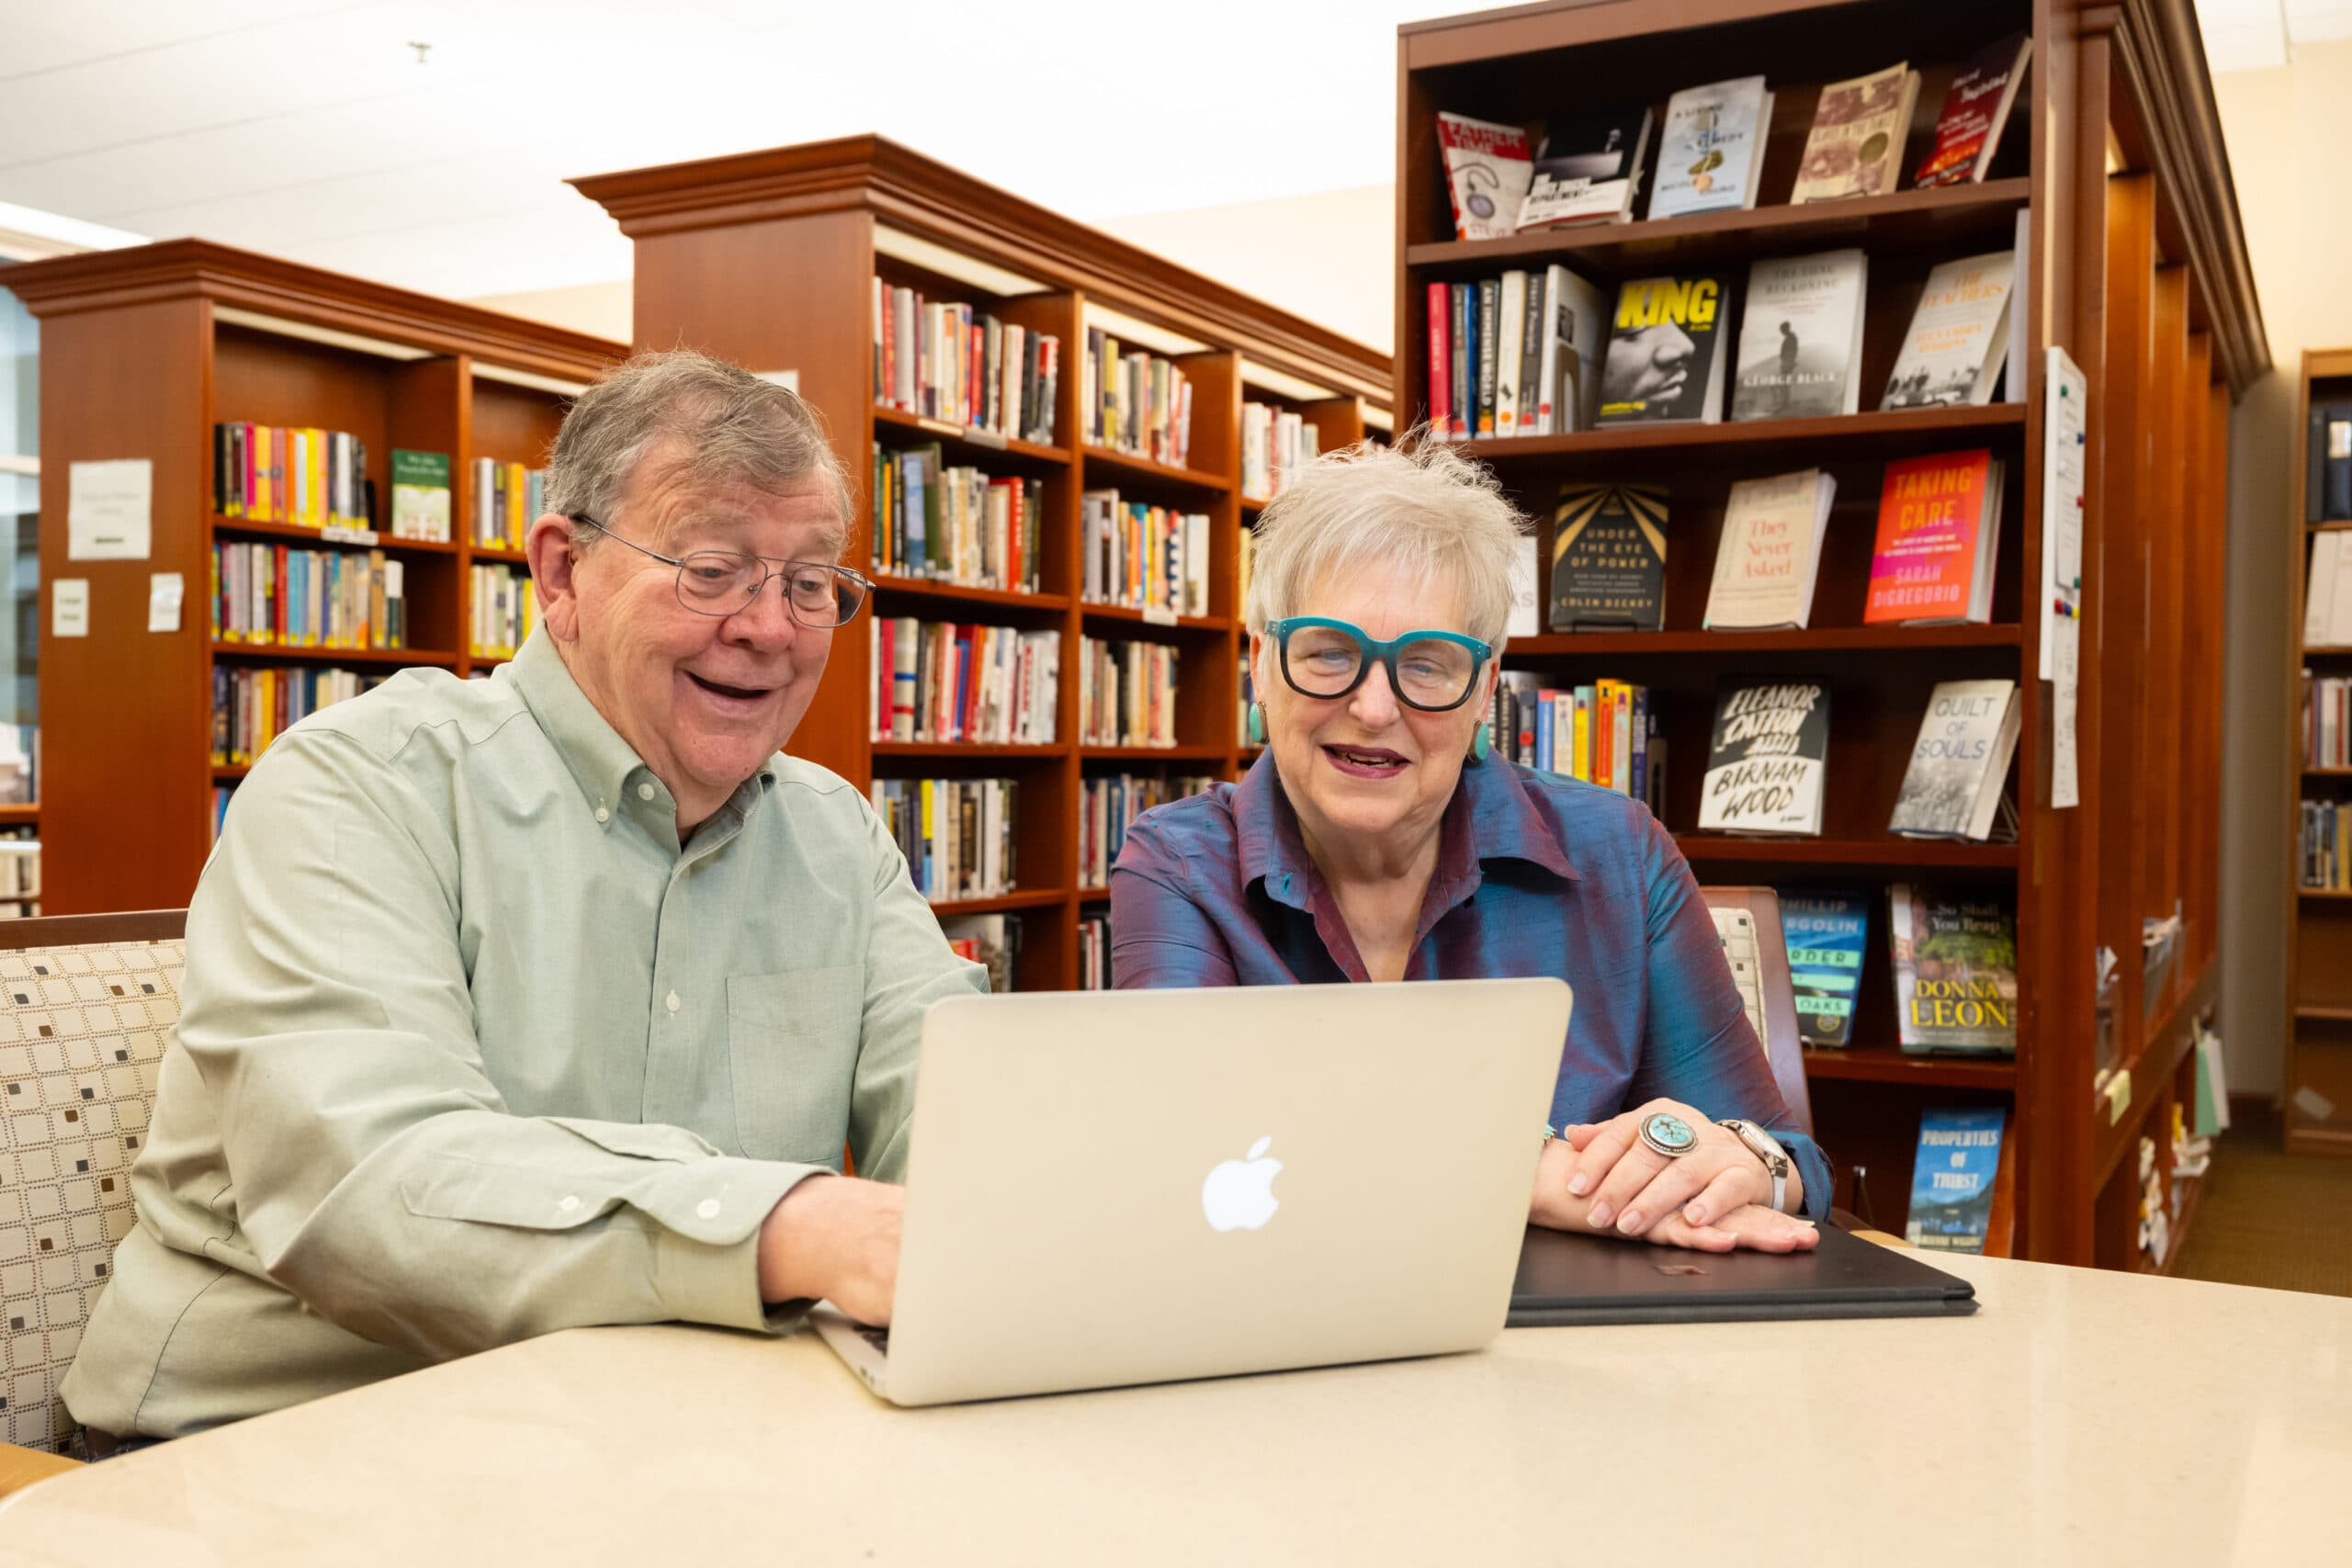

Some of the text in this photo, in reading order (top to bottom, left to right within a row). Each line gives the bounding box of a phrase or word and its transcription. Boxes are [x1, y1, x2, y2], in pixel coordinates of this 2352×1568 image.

[1446, 121, 1521, 148] FATHER
[1454, 137, 1496, 154] TIME
[1617, 278, 1719, 329] KING
[1743, 371, 1838, 388] GEORGE BLACK
[1895, 467, 1973, 500] TAKING
[1899, 500, 1956, 531] CARE
[1587, 529, 1637, 538] UNDER
[1751, 520, 1788, 539] They
[1579, 543, 1643, 554] THE EYE
[1747, 542, 1793, 557] Never
[1571, 557, 1648, 569] OF POWER
[1746, 559, 1792, 579] Asked
[1894, 565, 1941, 585] SARAH
[1561, 598, 1653, 609] COLIN DICKEY
[1723, 684, 1822, 720] ELEANOR
[1935, 695, 1996, 716] QUILT
[1946, 721, 1969, 736] OF
[1916, 739, 1985, 759] SOULS
[1713, 761, 1807, 796] BIRNAM
[1721, 786, 1794, 821] WOOD
[1786, 919, 1859, 933] RGOLIN
[1931, 916, 1960, 931] You
[1792, 950, 1847, 964] RDER
[1916, 978, 2000, 999] DONNA
[1799, 998, 1843, 1011] OAKS
[1910, 998, 2009, 1028] LEON
[1921, 1129, 1999, 1147] PROPERTIES
[1950, 1151, 1969, 1169] OF
[1932, 1171, 1981, 1190] THIRST
